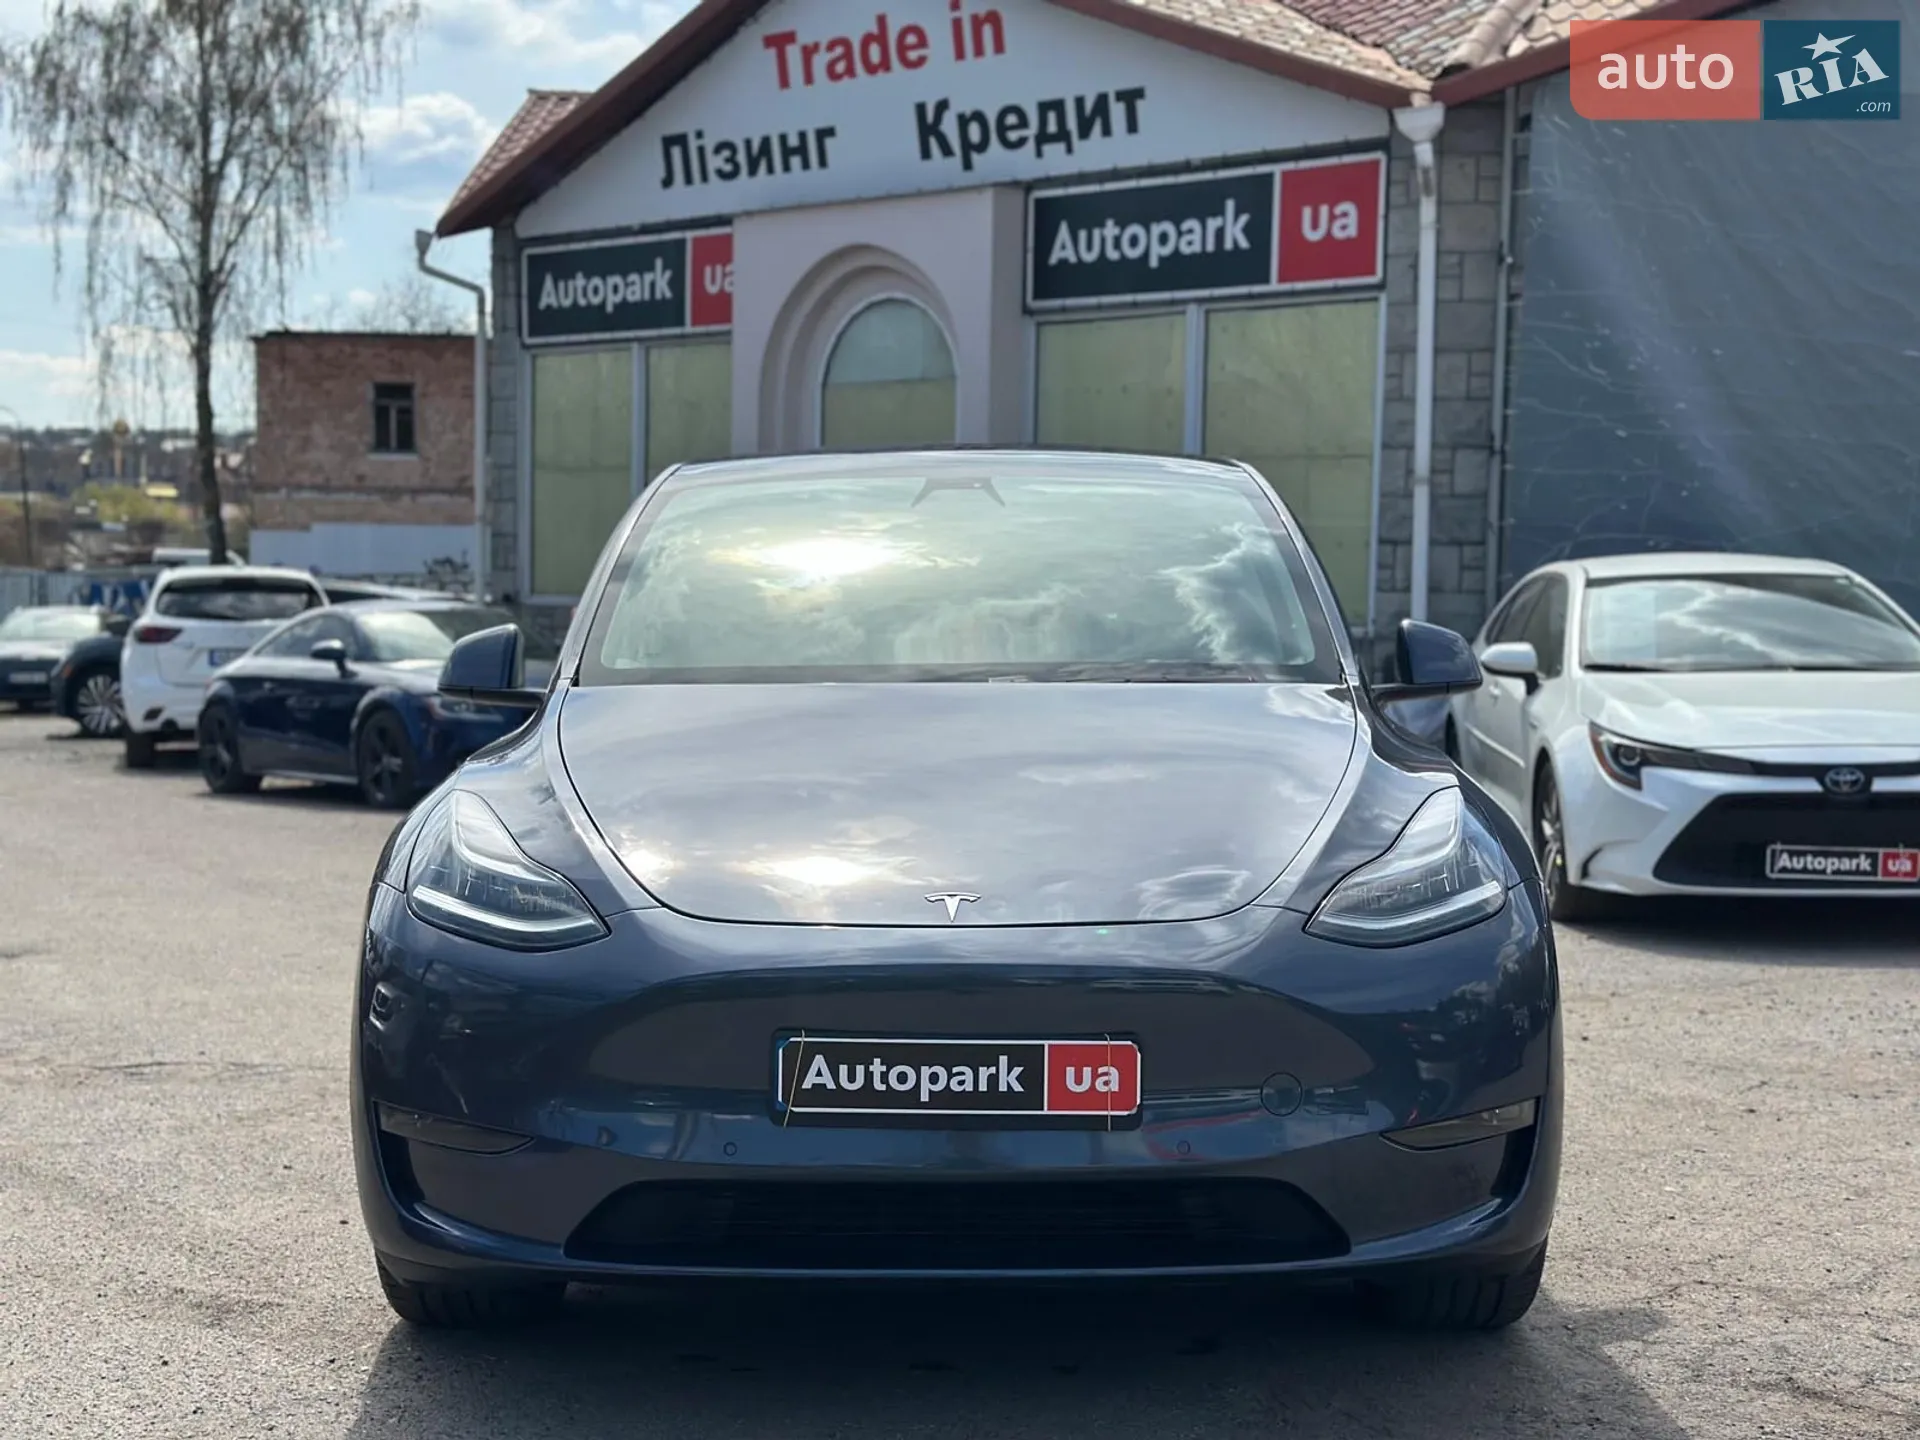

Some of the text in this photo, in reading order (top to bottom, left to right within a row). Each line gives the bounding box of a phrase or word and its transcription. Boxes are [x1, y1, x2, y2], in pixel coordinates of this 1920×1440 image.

[762, 0, 1006, 90] Trade in
[659, 87, 1146, 190] Лізинг Кредит
[1048, 200, 1359, 270] Autopark ua
[539, 258, 674, 313] Autopark
[1777, 852, 1912, 875] Autopark ua
[801, 1054, 1121, 1102] Autopark ua
